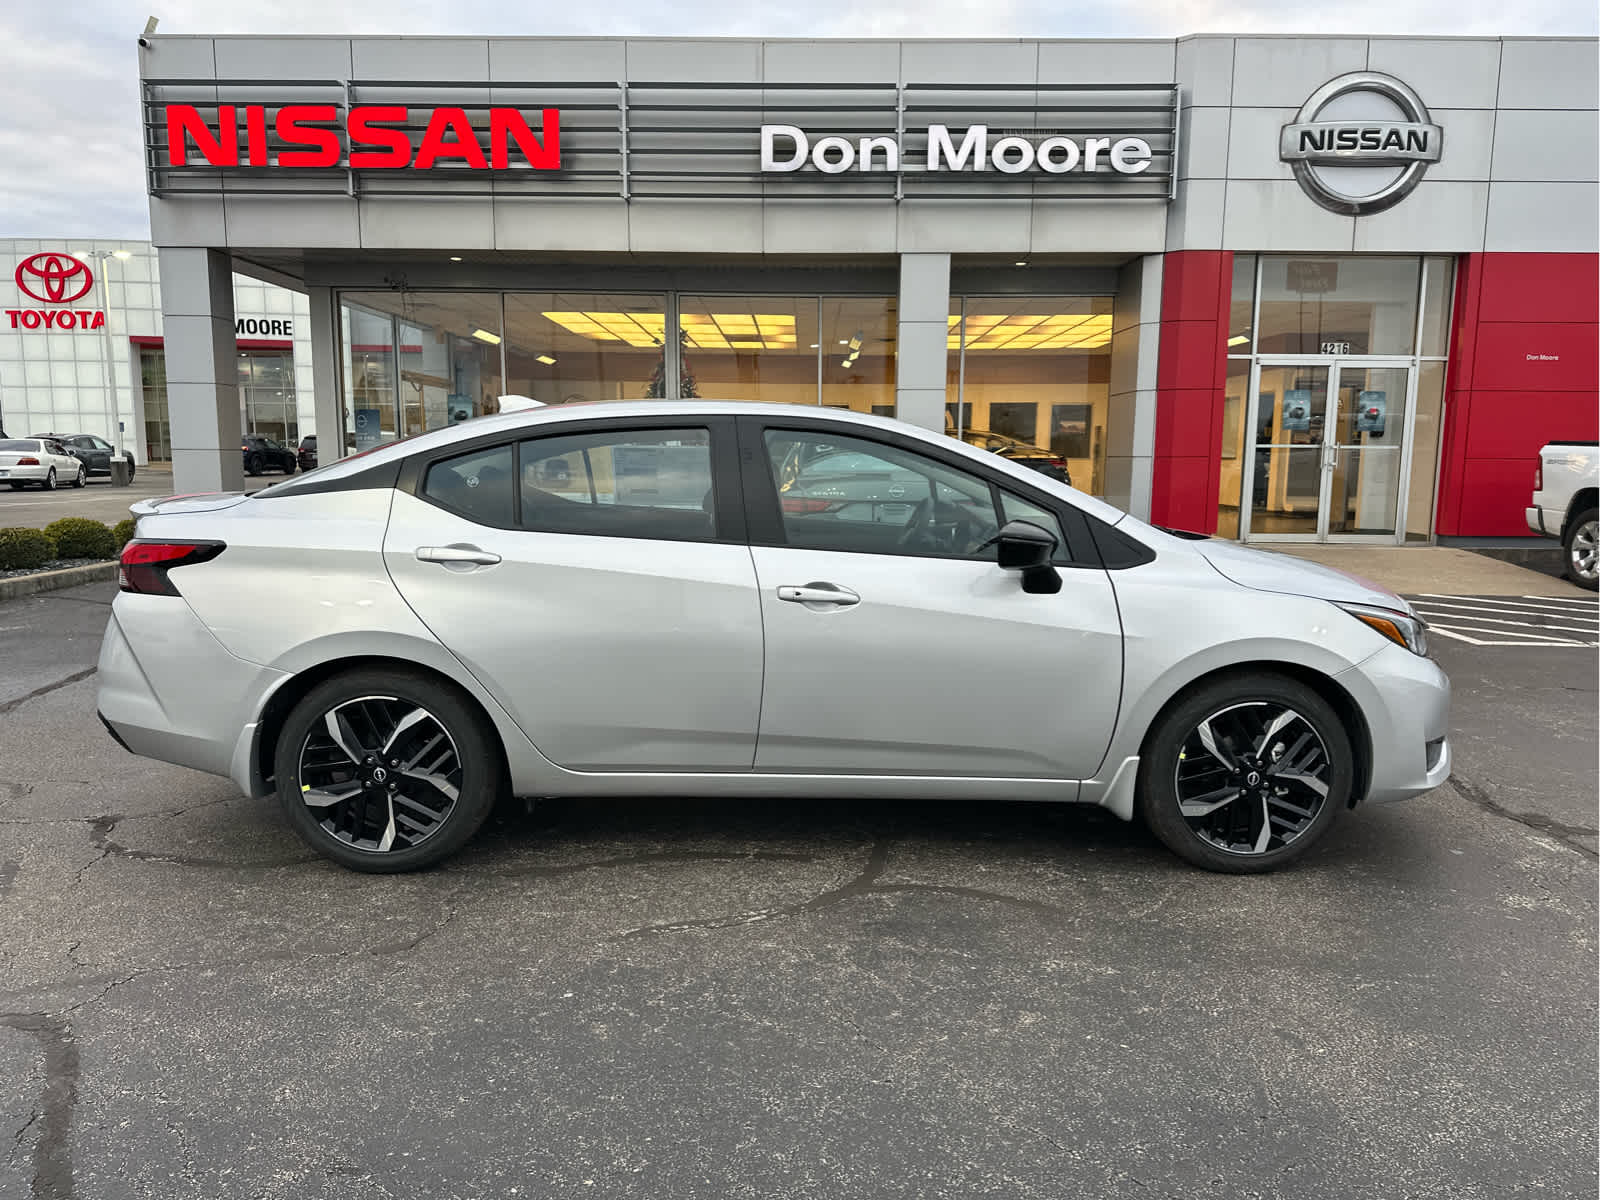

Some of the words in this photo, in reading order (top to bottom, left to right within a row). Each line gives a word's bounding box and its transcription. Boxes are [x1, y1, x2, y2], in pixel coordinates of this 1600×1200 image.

[166, 105, 560, 170] NISSAN
[760, 124, 898, 174] Don
[927, 124, 1152, 174] Moore
[1299, 128, 1428, 153] NISSAN
[5, 310, 104, 330] TOYOTA
[1321, 343, 1349, 356] 4216
